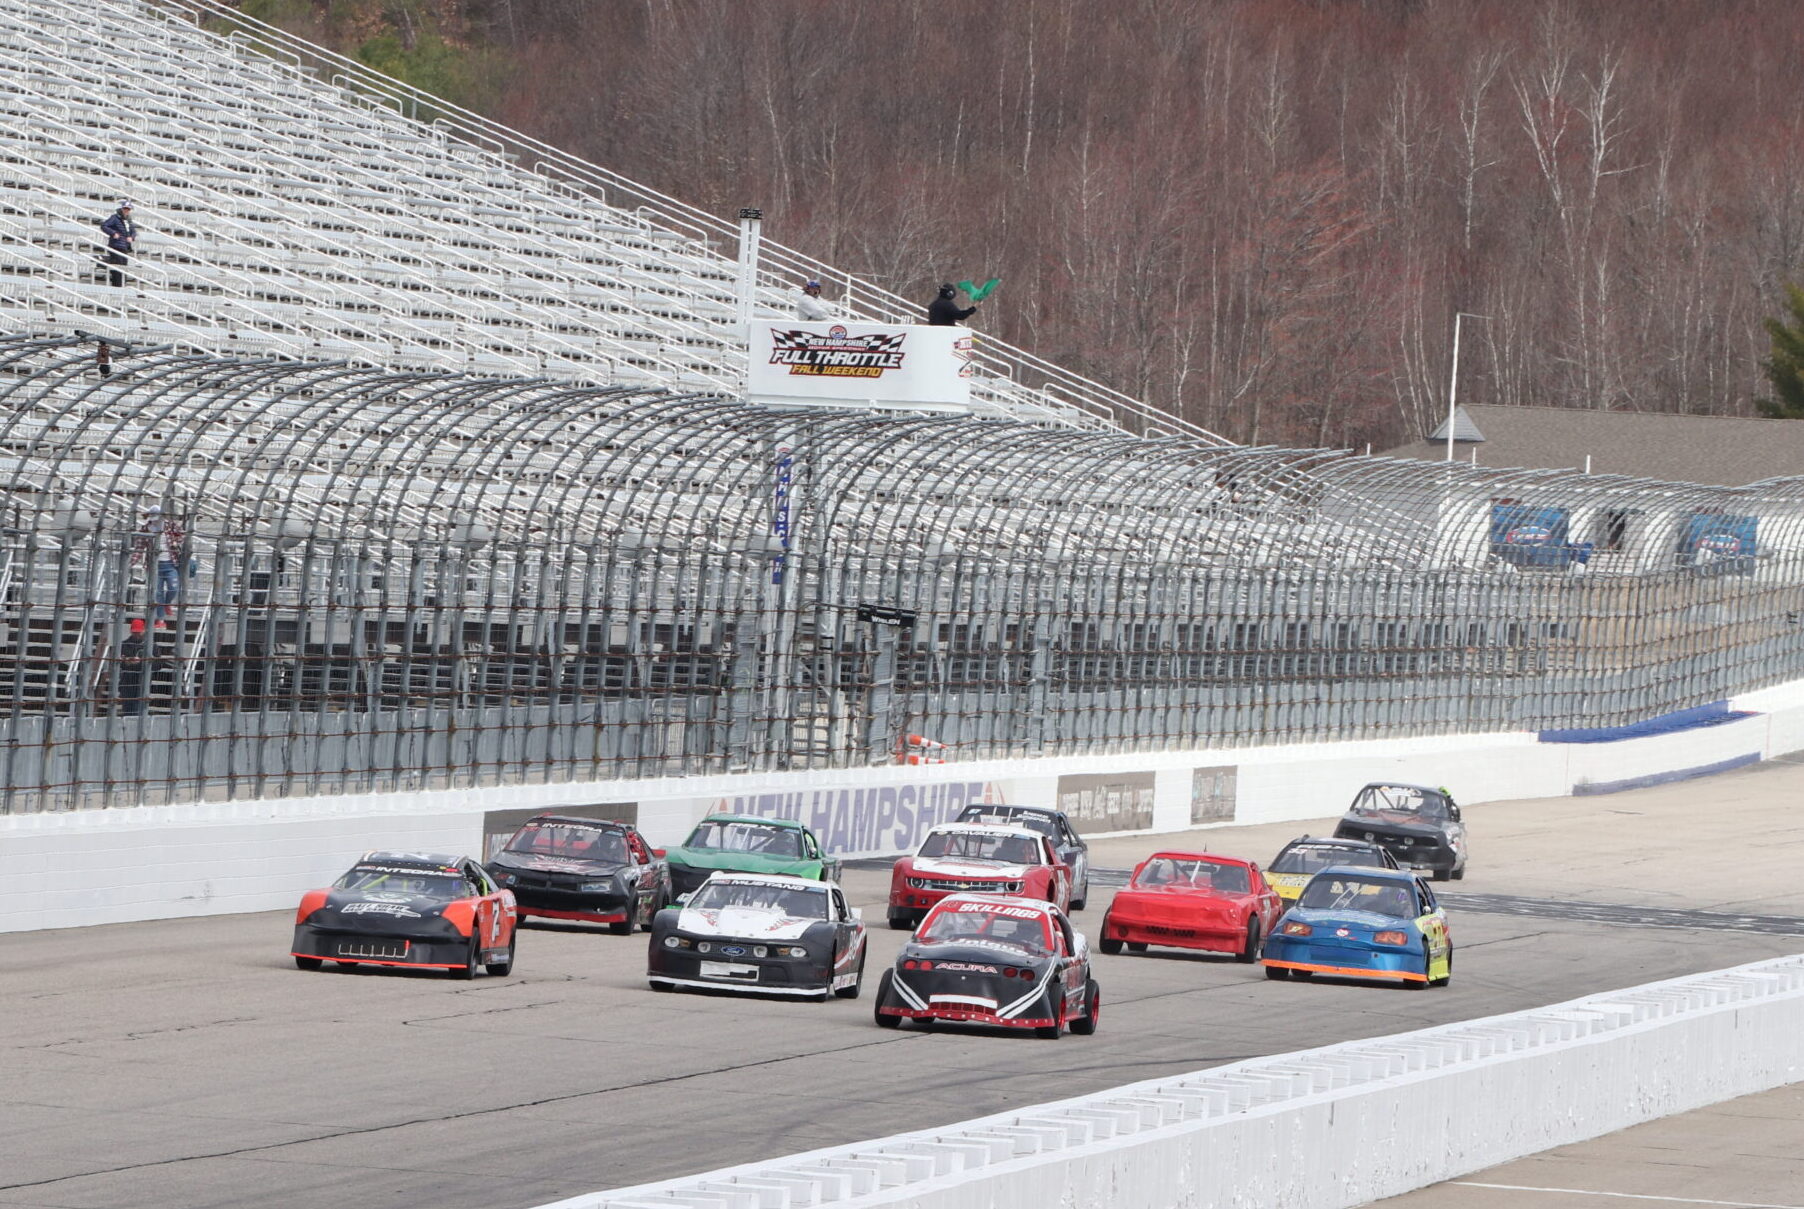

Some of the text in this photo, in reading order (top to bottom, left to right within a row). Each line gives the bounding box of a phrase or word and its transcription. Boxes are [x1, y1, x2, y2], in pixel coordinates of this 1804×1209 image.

[809, 338, 868, 347] NEW HAMPSHIRE
[771, 350, 902, 367] FULL THROTTLE
[791, 365, 881, 377] FALL WEEKEND
[542, 823, 602, 833] INTEGRA
[376, 866, 443, 876] INTEGRA
[731, 879, 806, 891] MUSTANG
[958, 902, 1041, 919] SKILLINGS
[935, 962, 998, 974] ACURA
